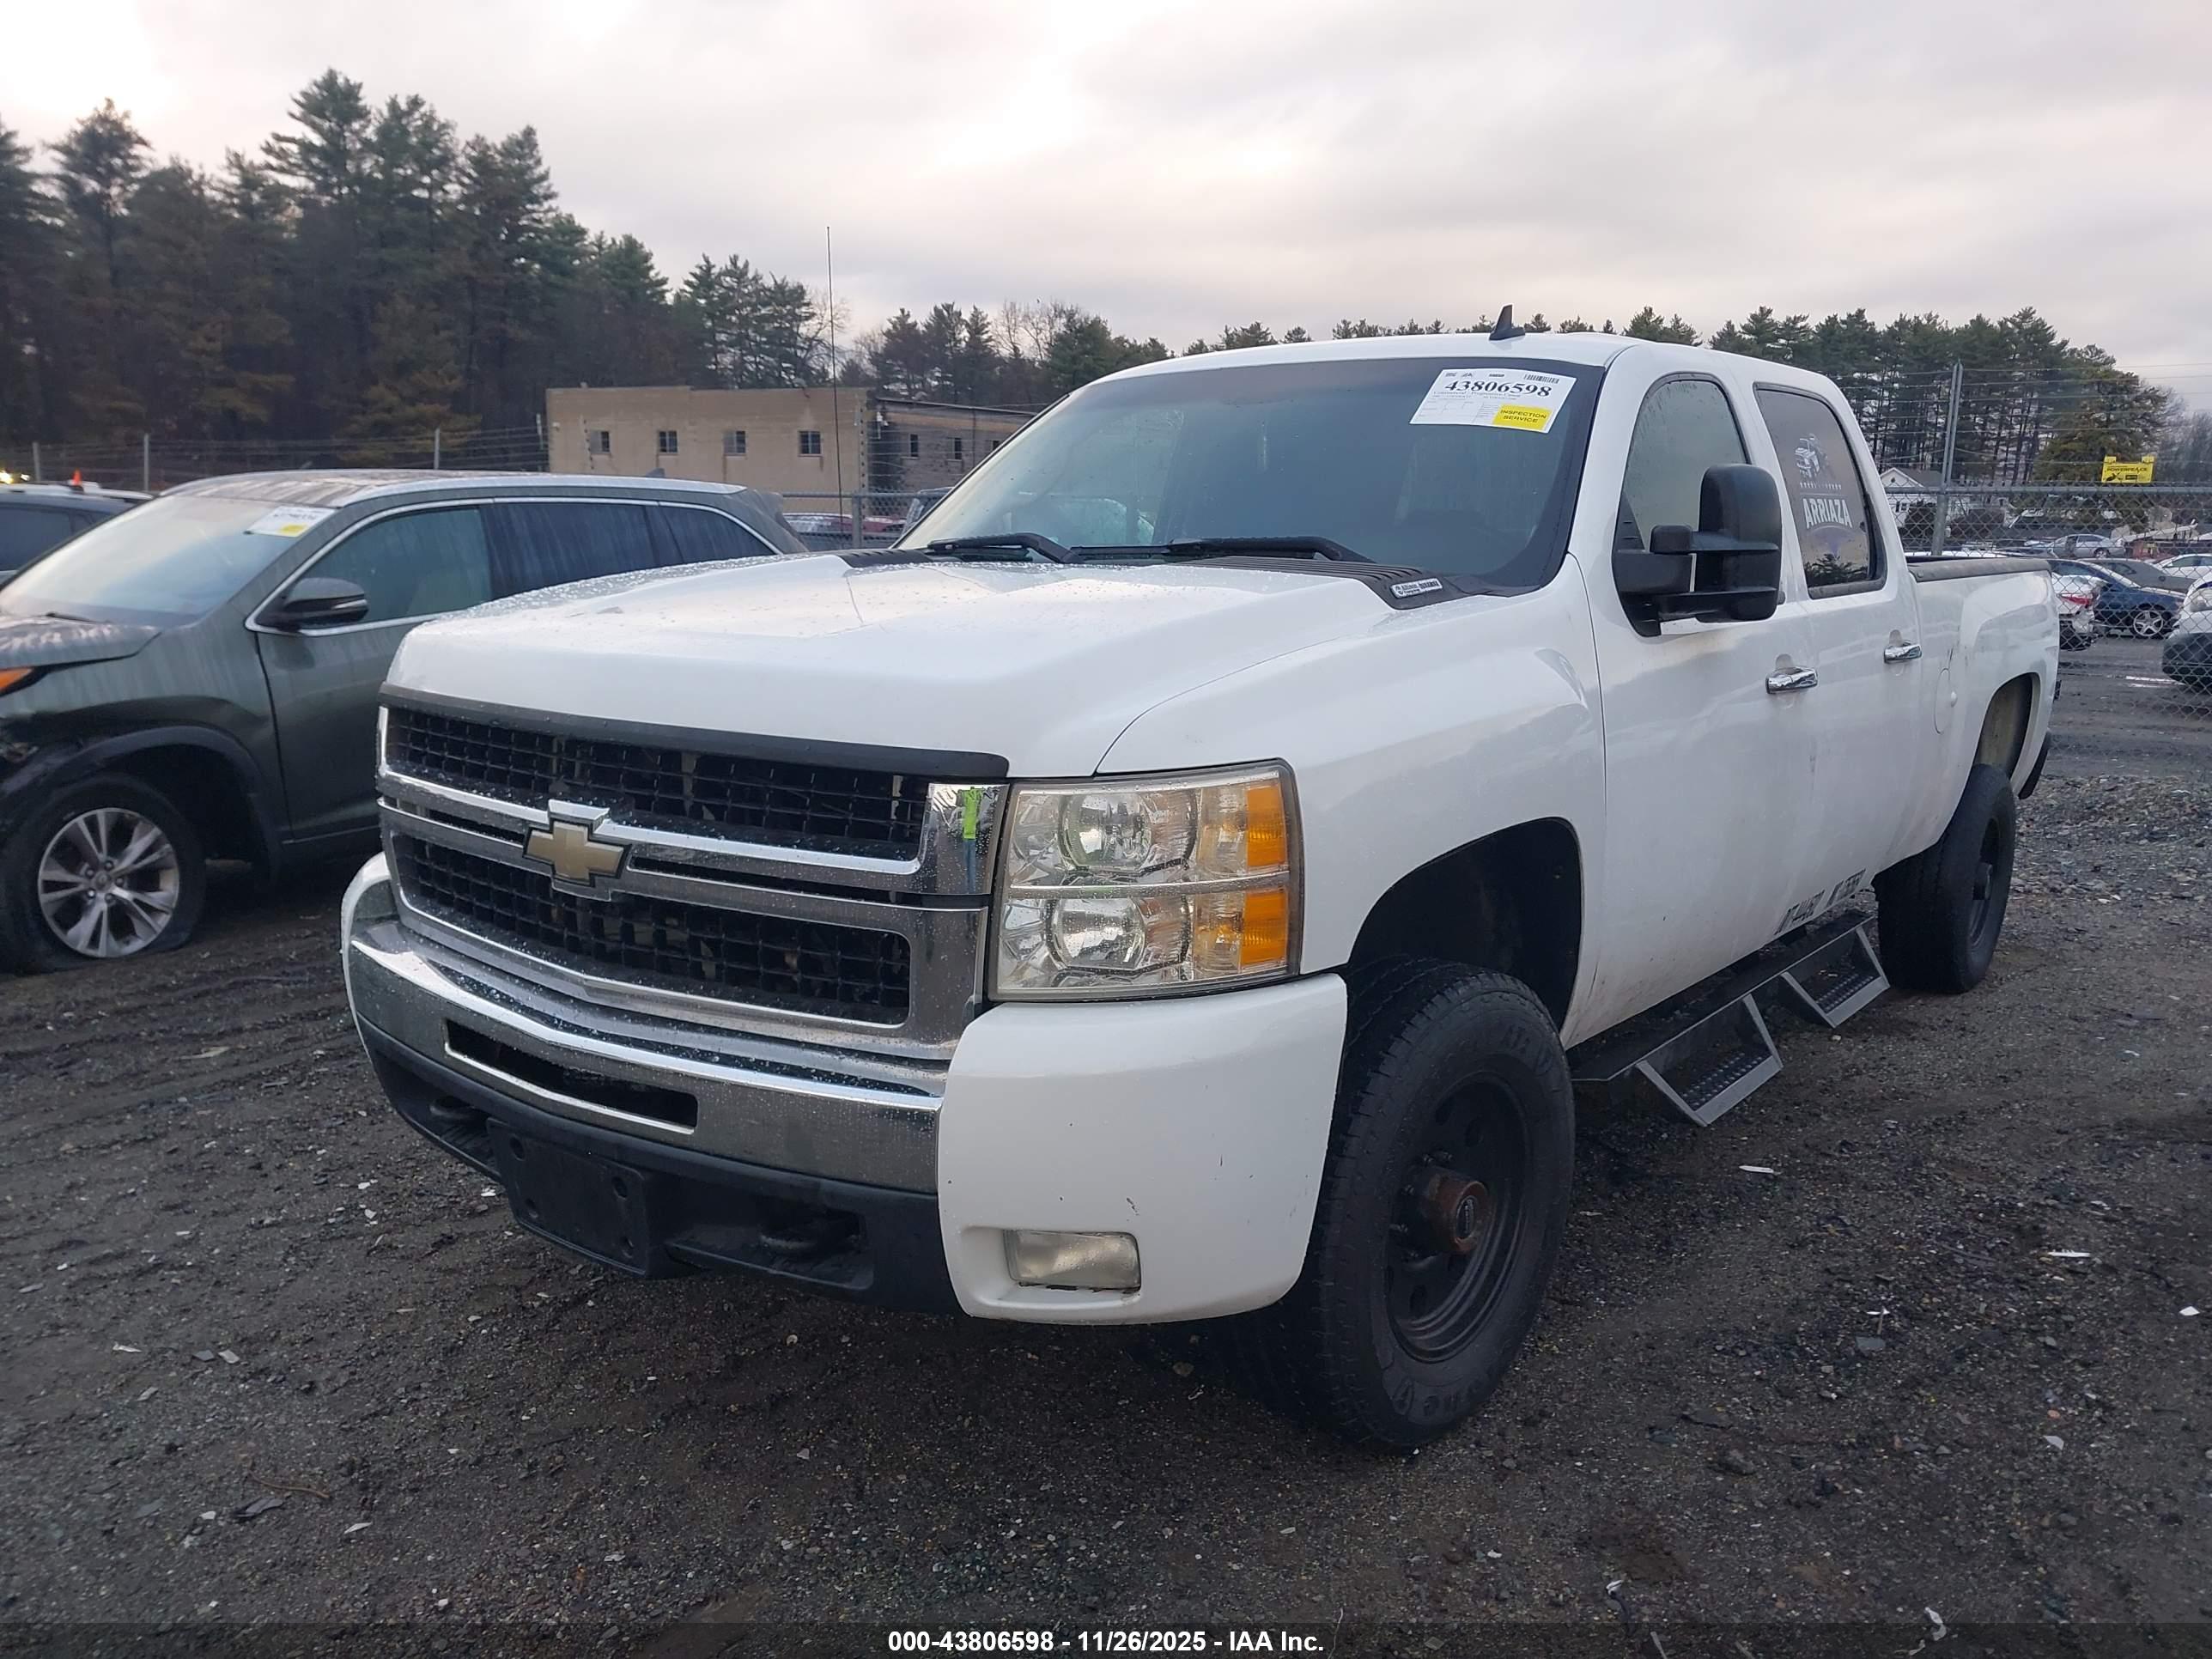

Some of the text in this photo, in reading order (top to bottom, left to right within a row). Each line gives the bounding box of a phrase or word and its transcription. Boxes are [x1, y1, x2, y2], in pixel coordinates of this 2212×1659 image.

[1445, 380, 1552, 397] 43806598
[1500, 410, 1547, 419] INSPECTION
[1503, 415, 1539, 423] SERVICE
[1802, 498, 1853, 529] ARRIAZA
